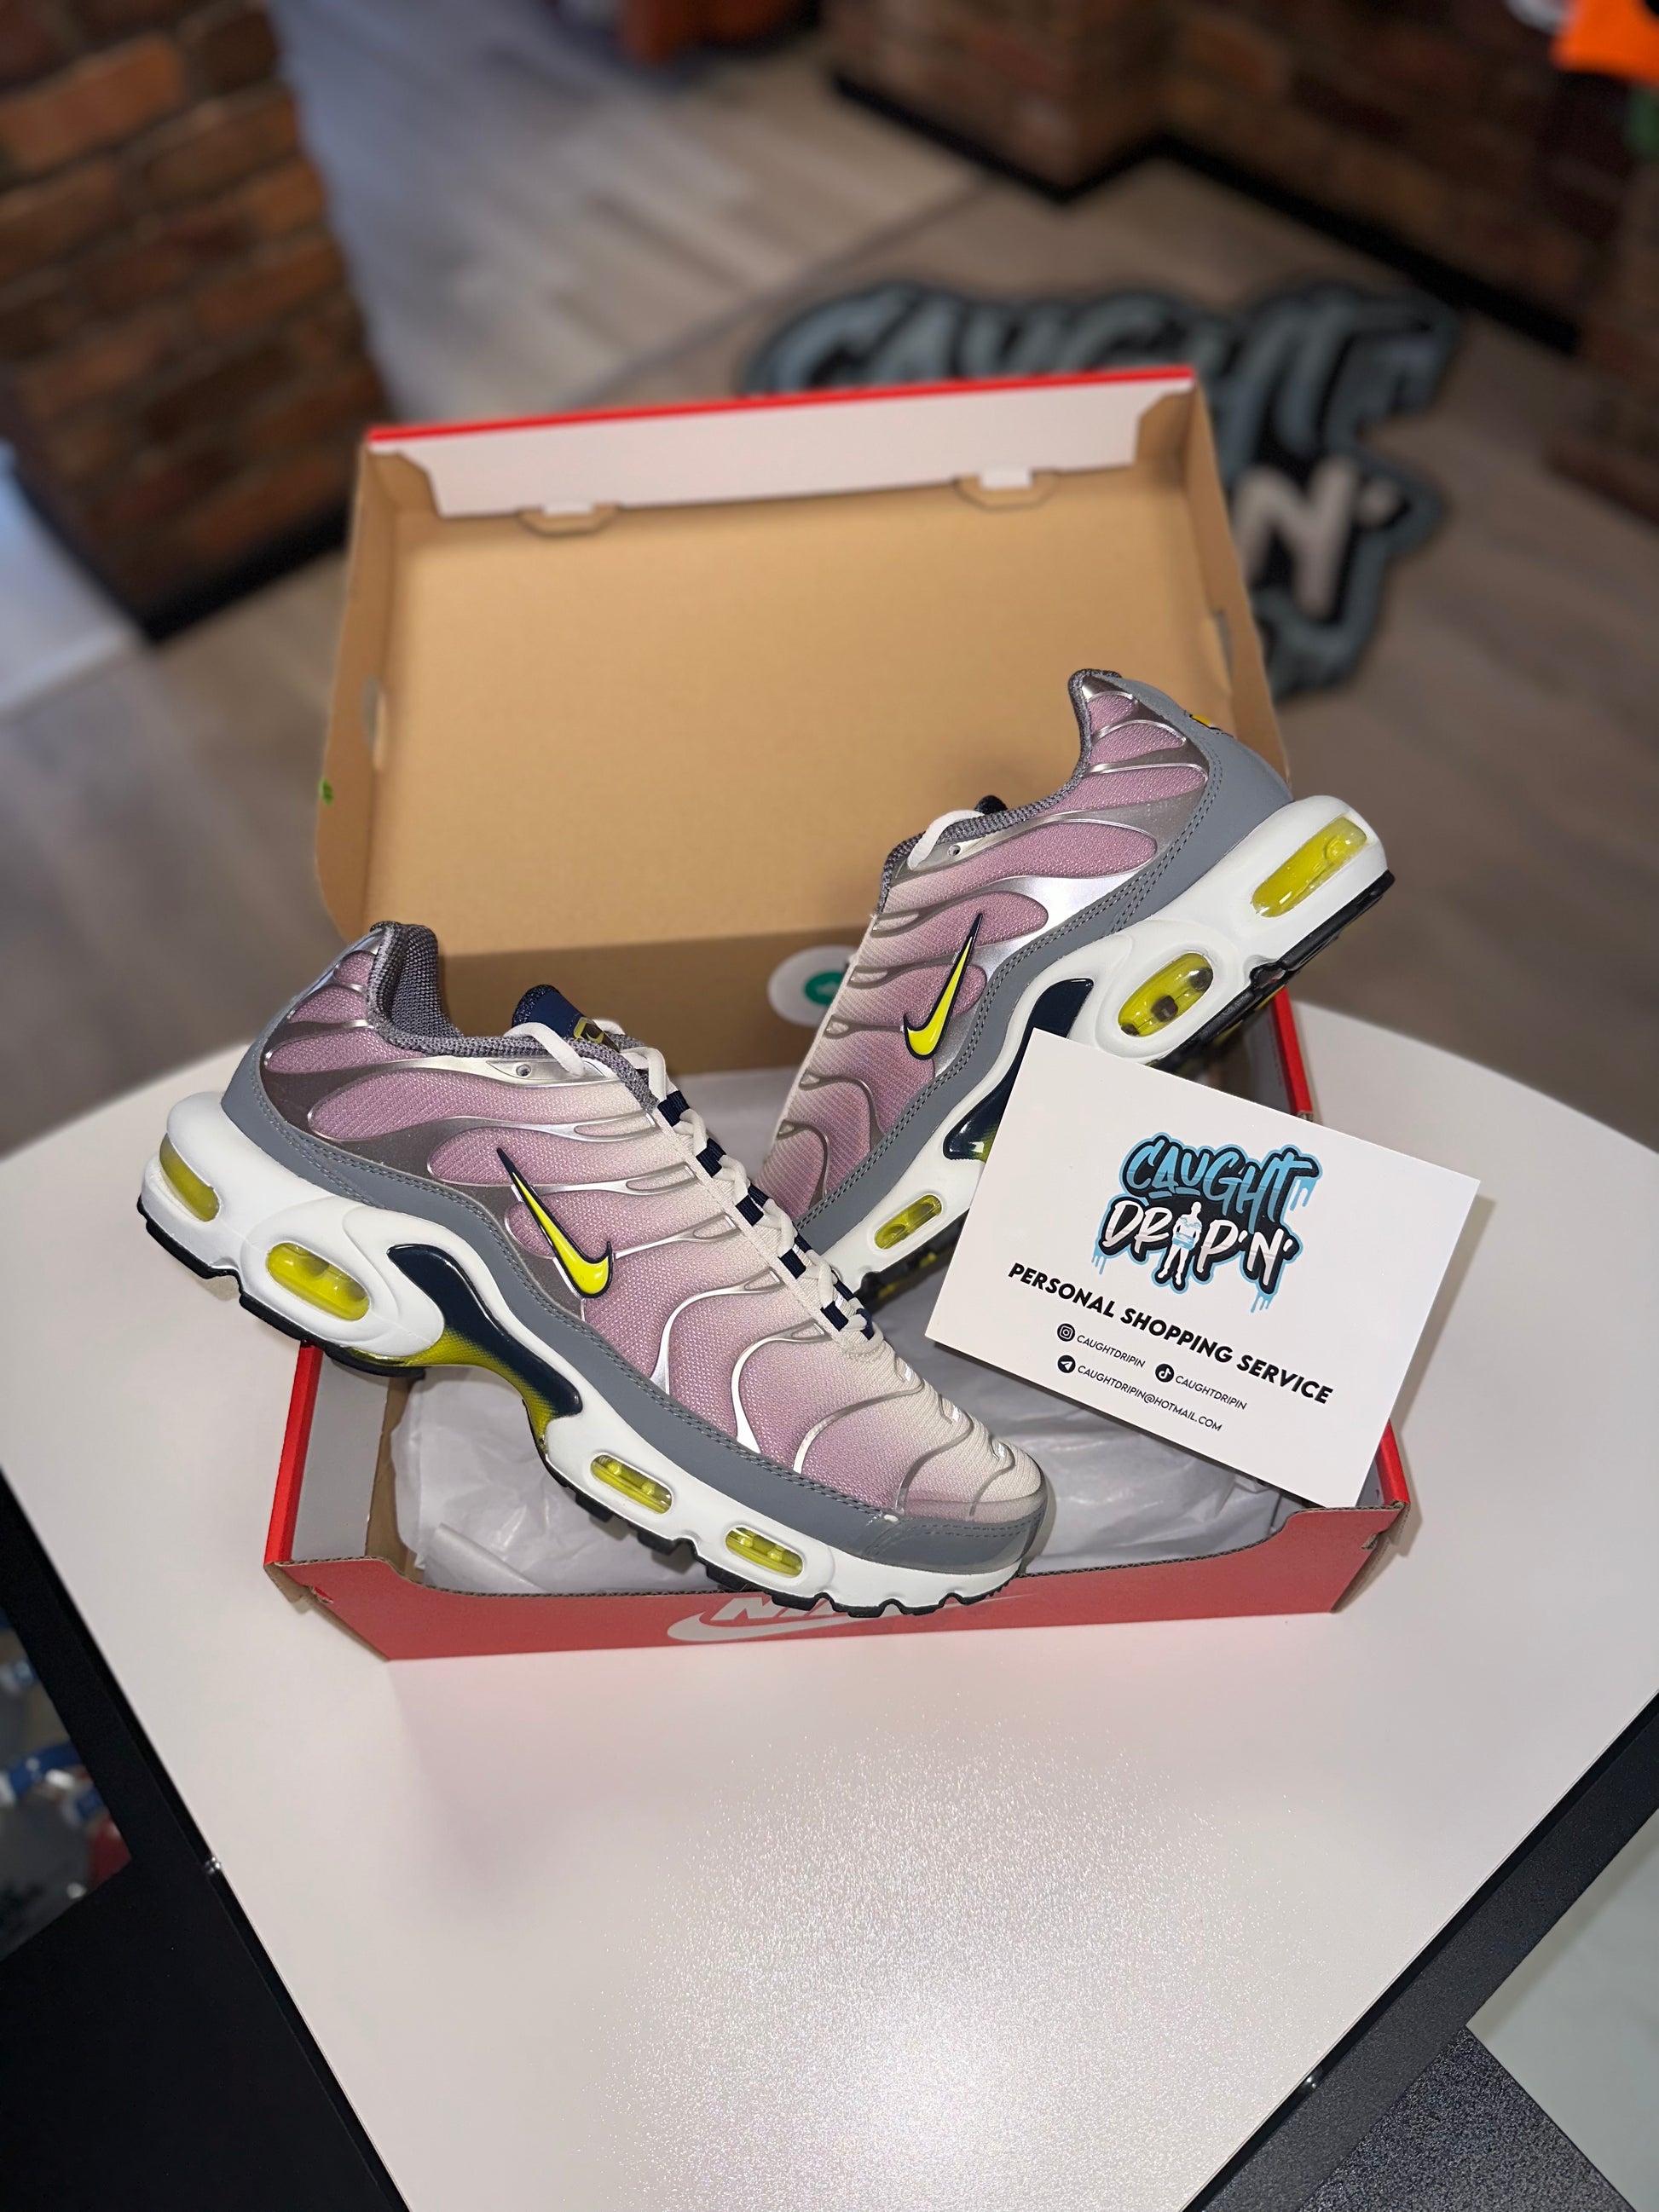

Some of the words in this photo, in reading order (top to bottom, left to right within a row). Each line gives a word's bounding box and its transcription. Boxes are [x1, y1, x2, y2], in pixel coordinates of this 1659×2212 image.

[1126, 1139, 1313, 1234] CAUGHT
[1008, 1262, 1115, 1318] PERSONAL
[1120, 1308, 1233, 1363] SHOPPING
[1236, 1354, 1333, 1405] SERVICE
[1077, 1335, 1146, 1368] CAUGHTDRIPIN
[1078, 1366, 1223, 1432] CAUGHTDRIPIN@HOTMAIL.COM
[1175, 1375, 1247, 1410] CAUGHTDRIPIN
